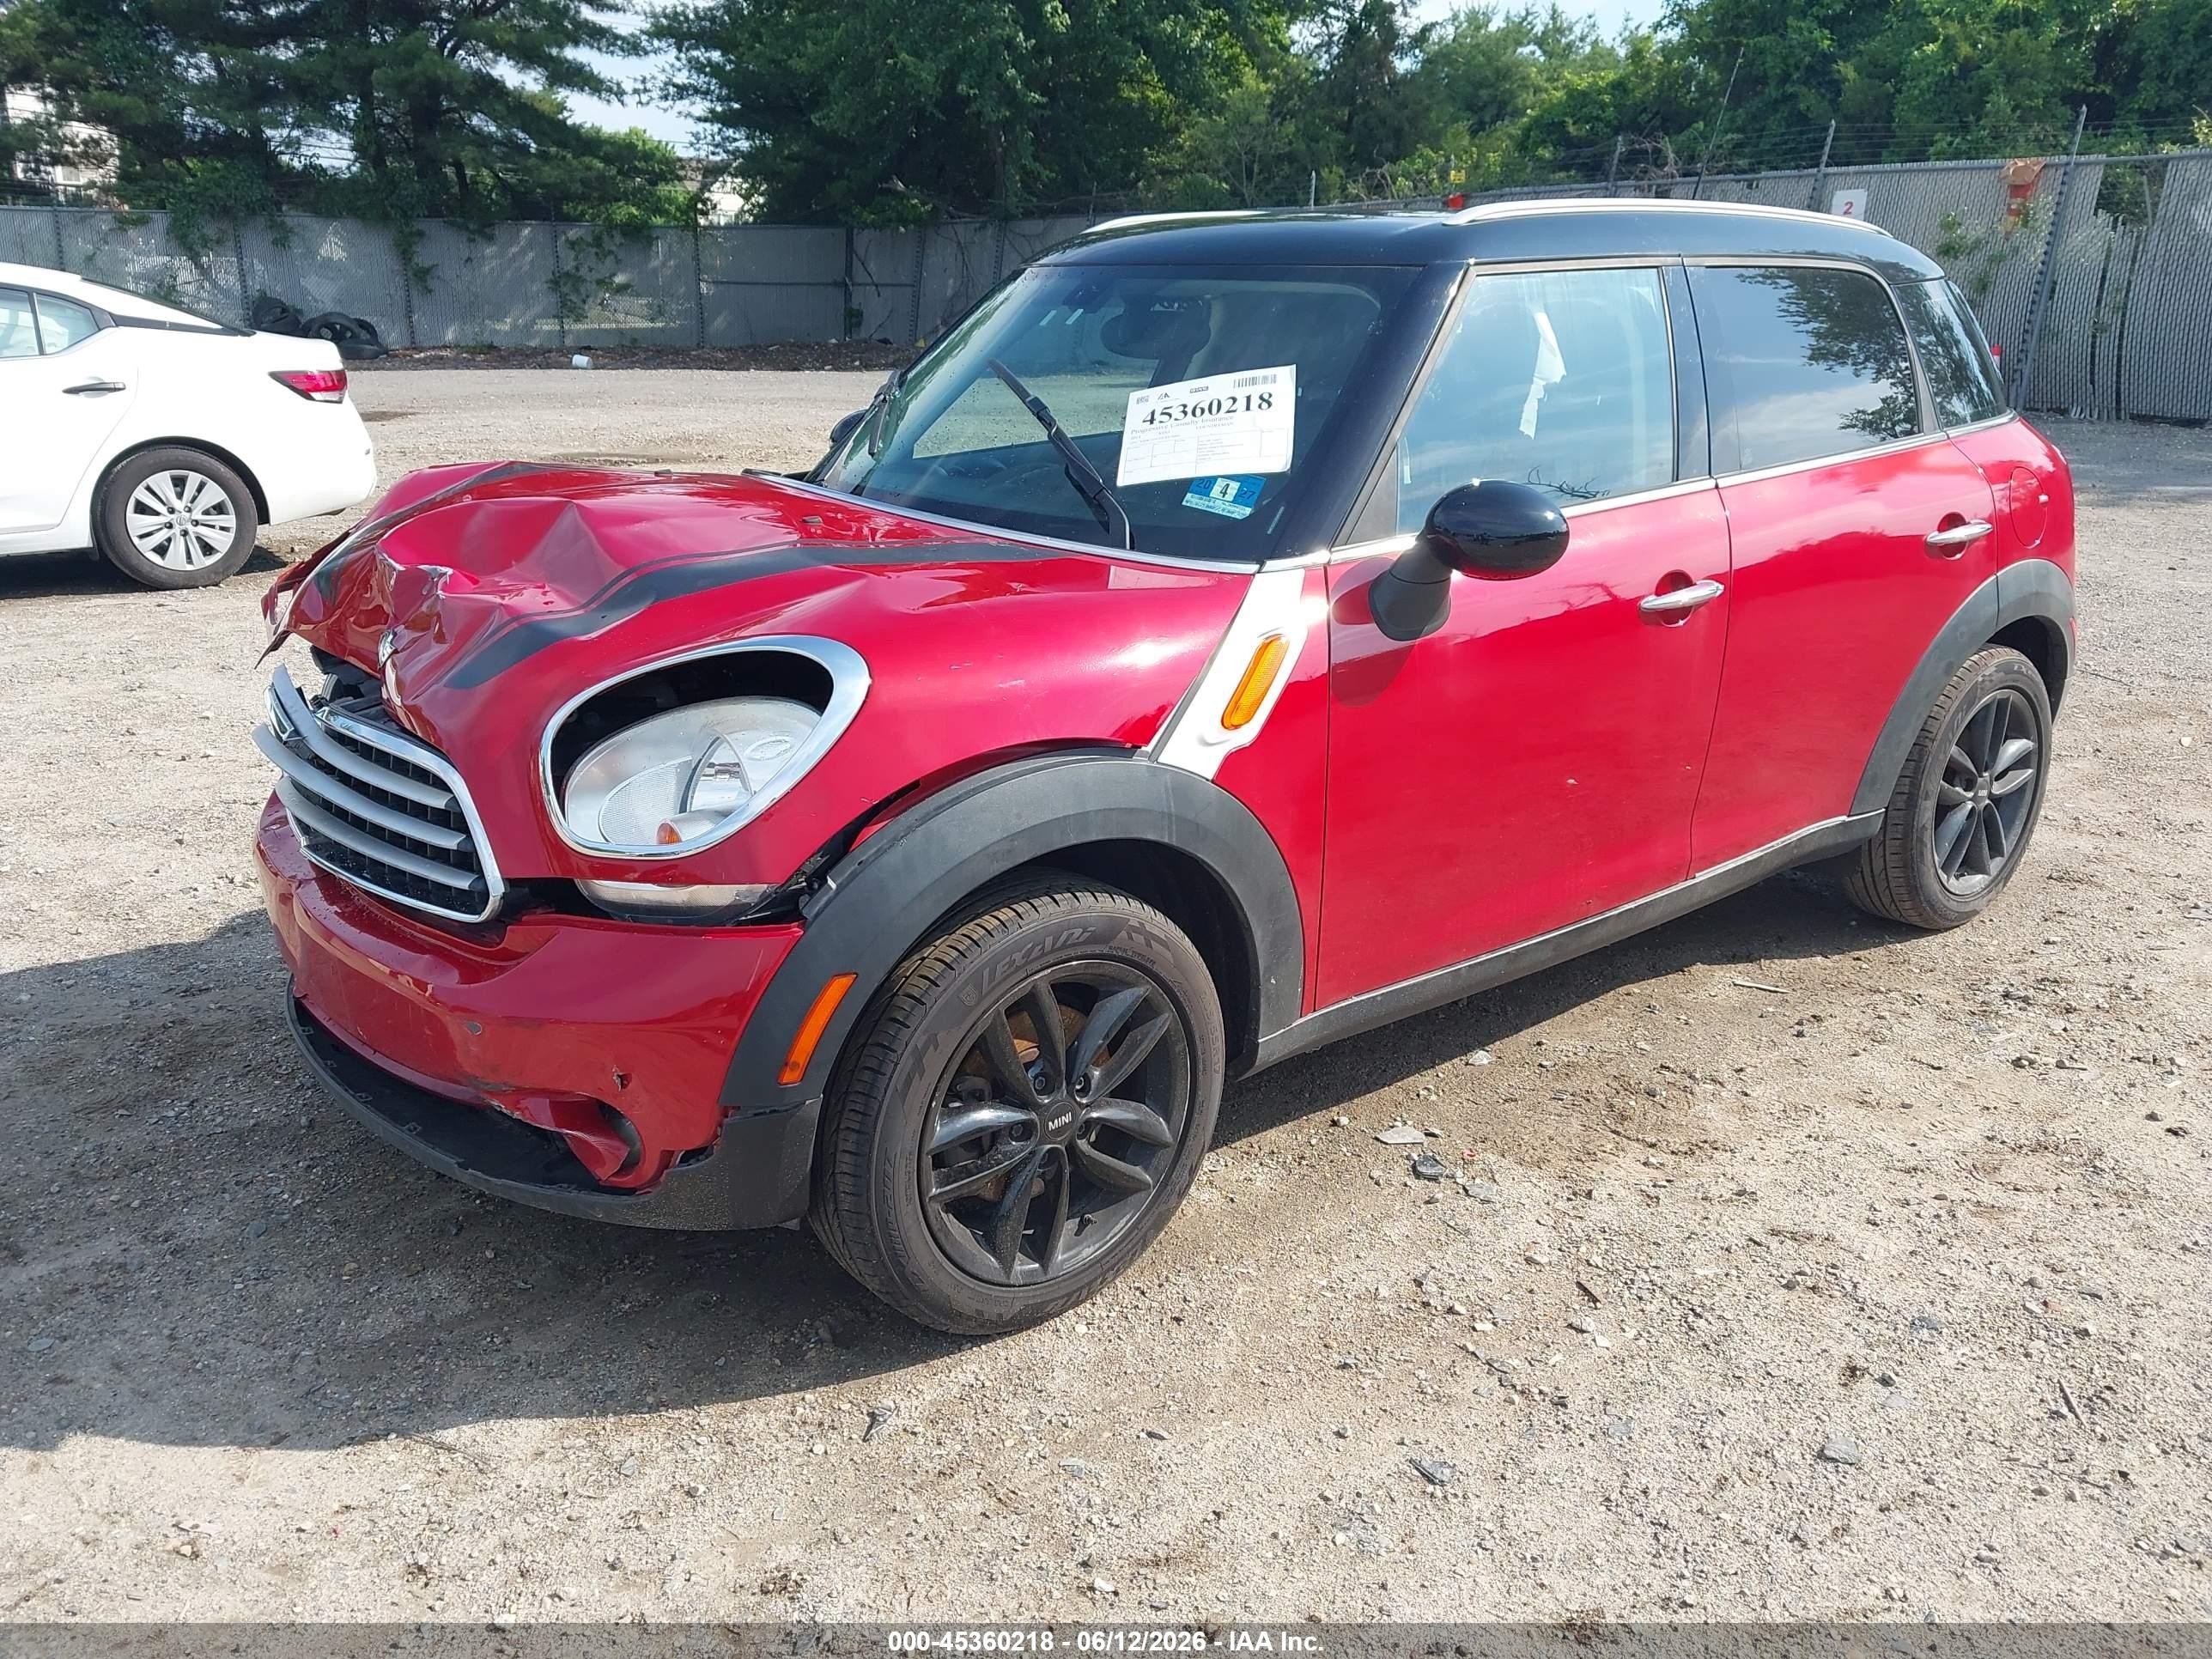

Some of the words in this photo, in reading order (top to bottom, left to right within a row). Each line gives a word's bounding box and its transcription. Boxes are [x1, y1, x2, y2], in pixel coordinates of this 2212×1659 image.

[1844, 202, 1853, 215] 2
[1142, 392, 1273, 425] 45360218
[1196, 478, 1212, 489] 20
[1219, 483, 1231, 498] 4
[1238, 487, 1256, 500] 27
[1048, 1111, 1073, 1132] MINI
